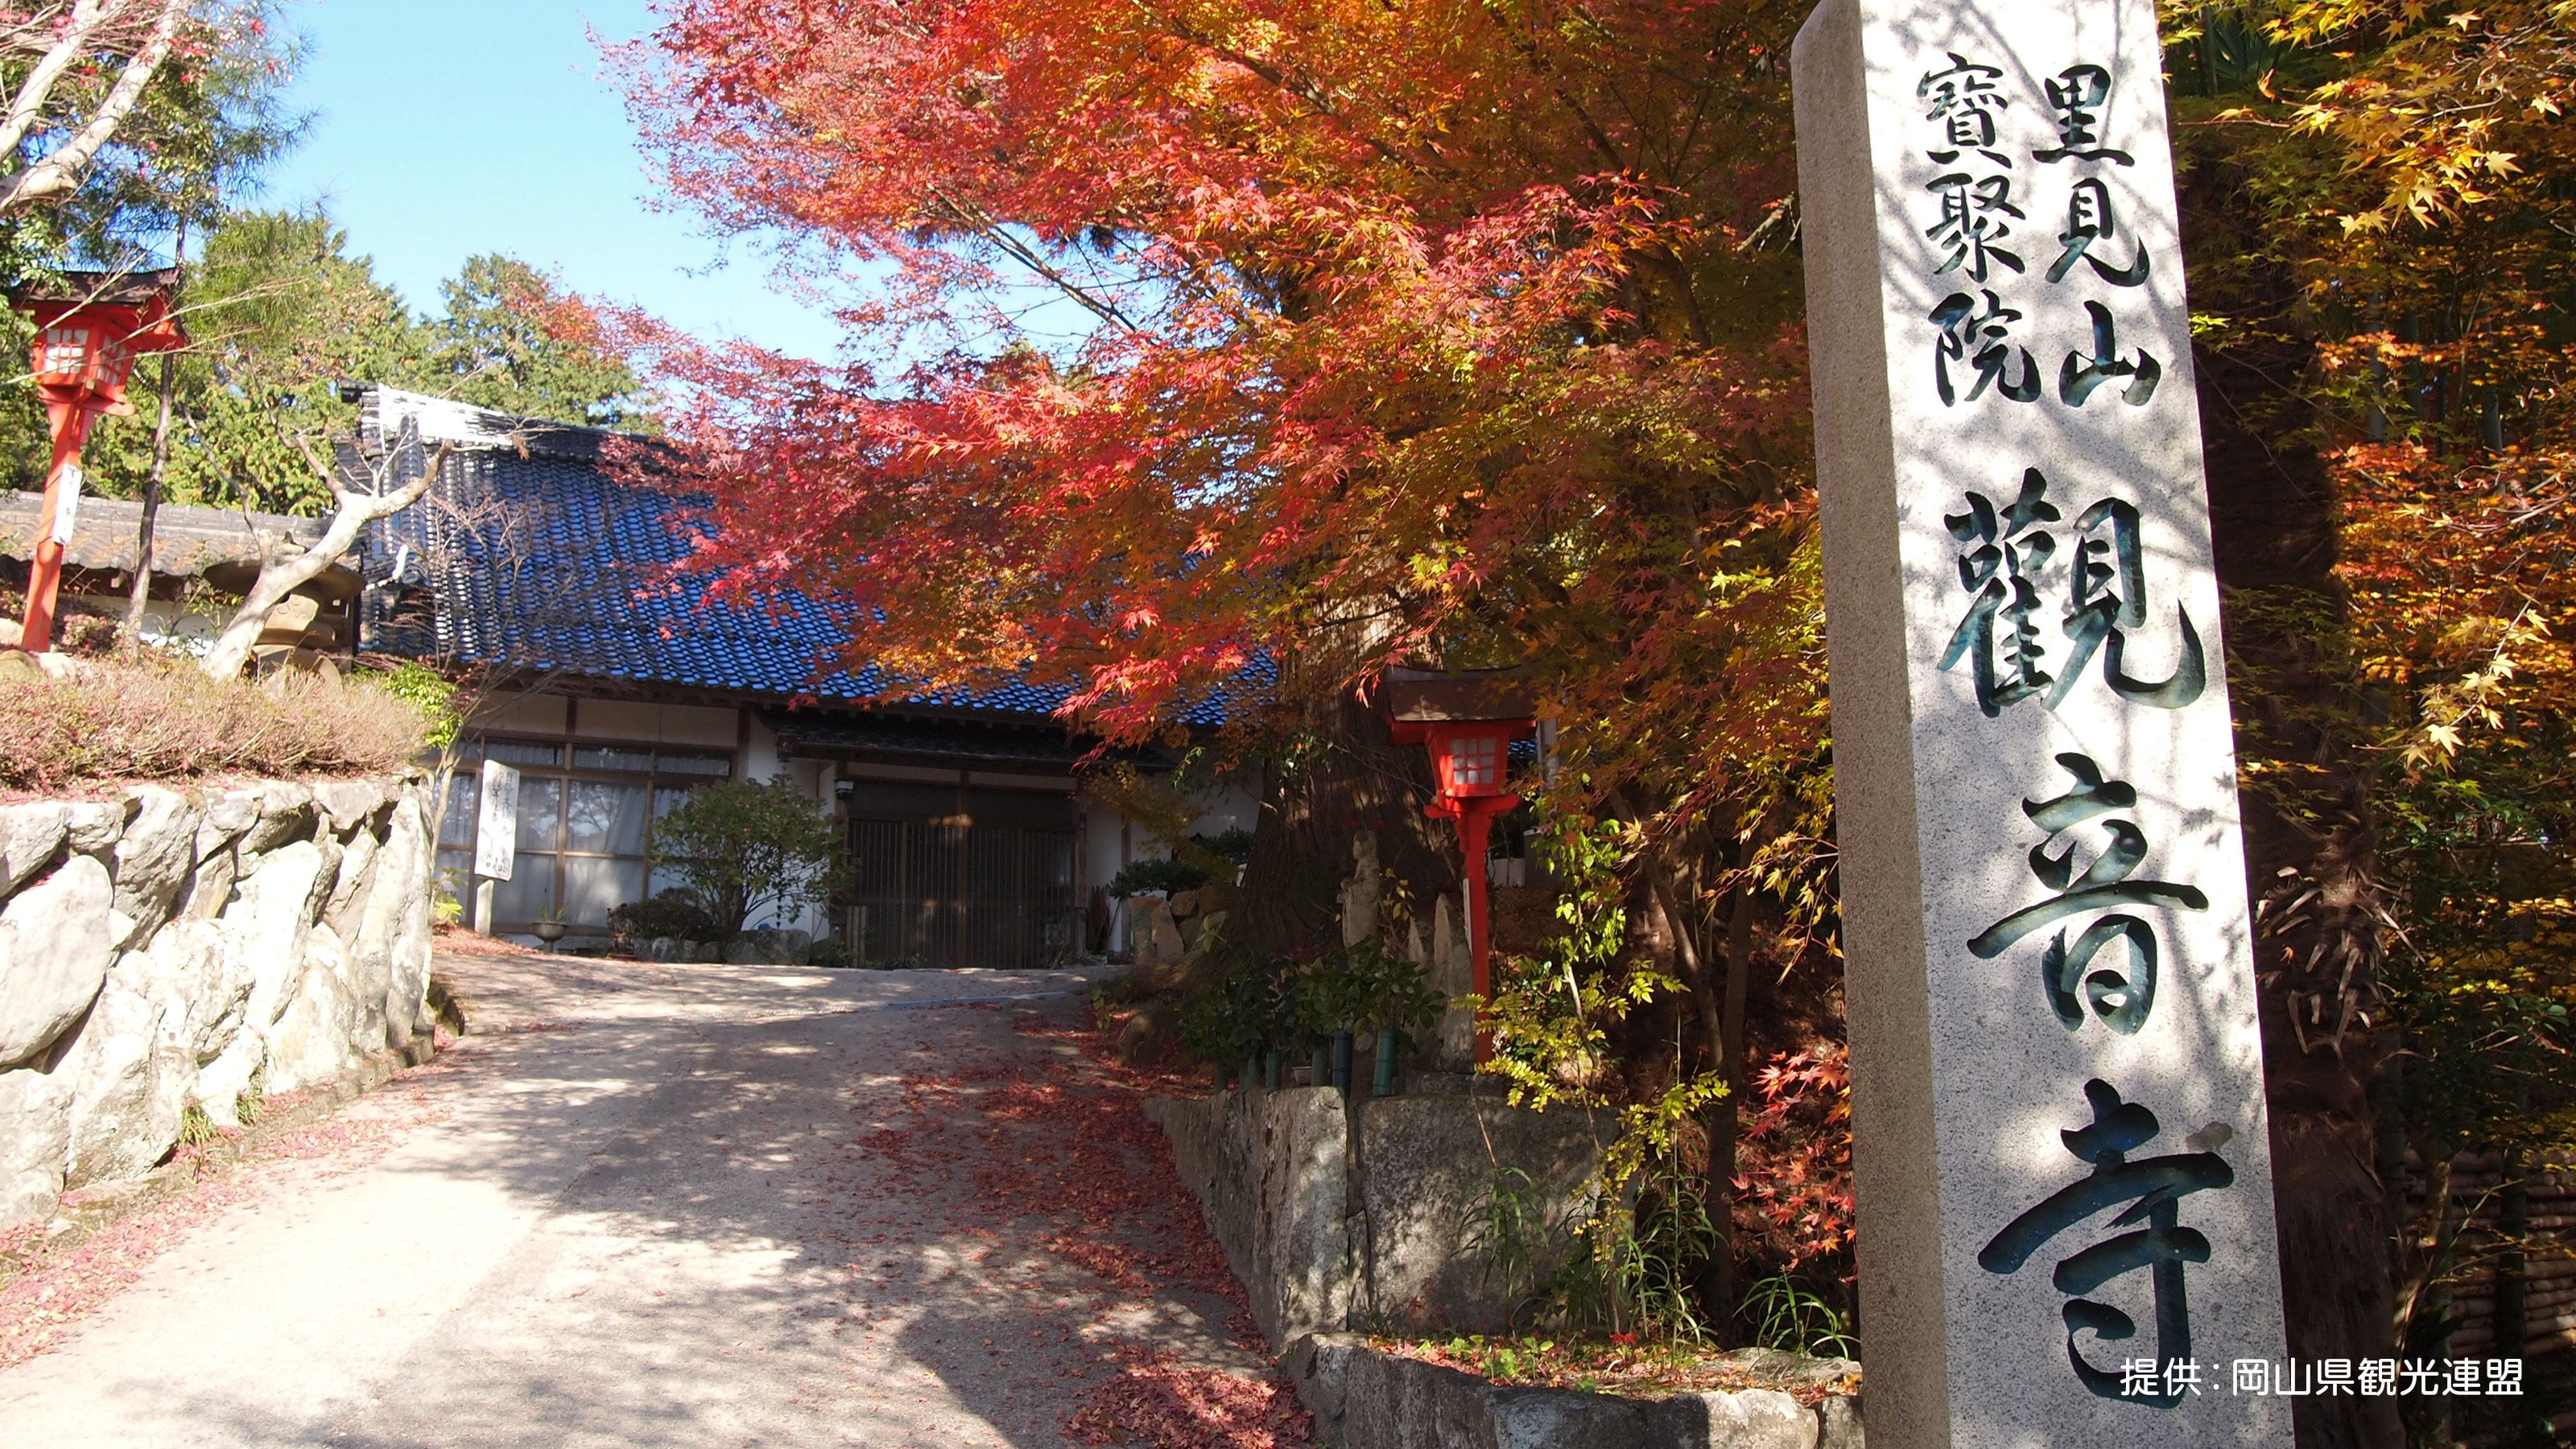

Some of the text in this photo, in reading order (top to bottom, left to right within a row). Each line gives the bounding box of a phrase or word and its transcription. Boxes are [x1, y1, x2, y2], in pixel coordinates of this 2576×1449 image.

[2032, 64, 2161, 407] 里見山
[1937, 467, 2235, 1409] 觀音寺
